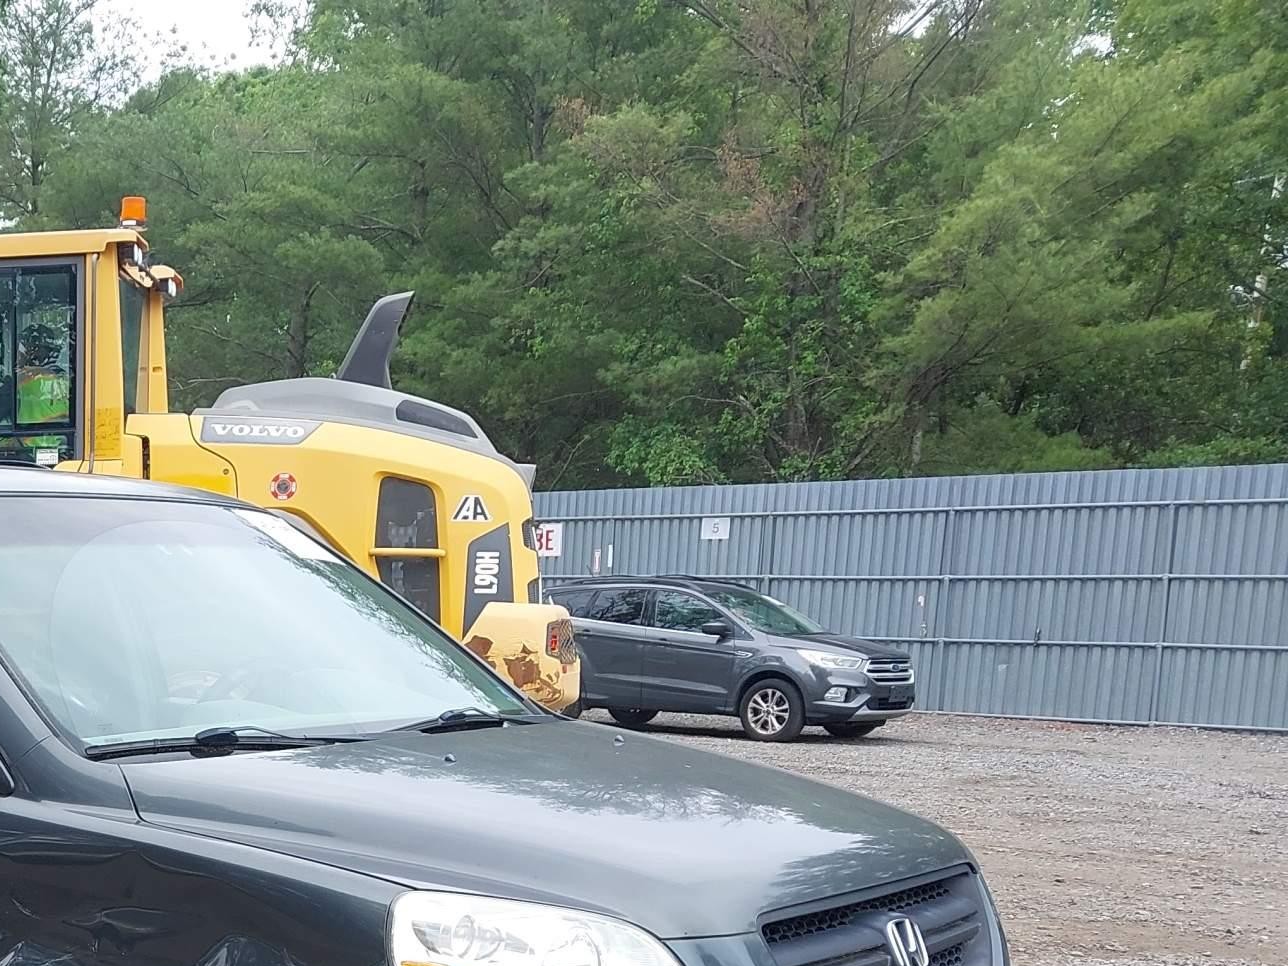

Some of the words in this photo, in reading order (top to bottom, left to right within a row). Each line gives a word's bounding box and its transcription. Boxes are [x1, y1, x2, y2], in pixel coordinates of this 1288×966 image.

[211, 423, 305, 438] VOLVO
[712, 522, 720, 534] 5
[473, 551, 500, 594] L90H
